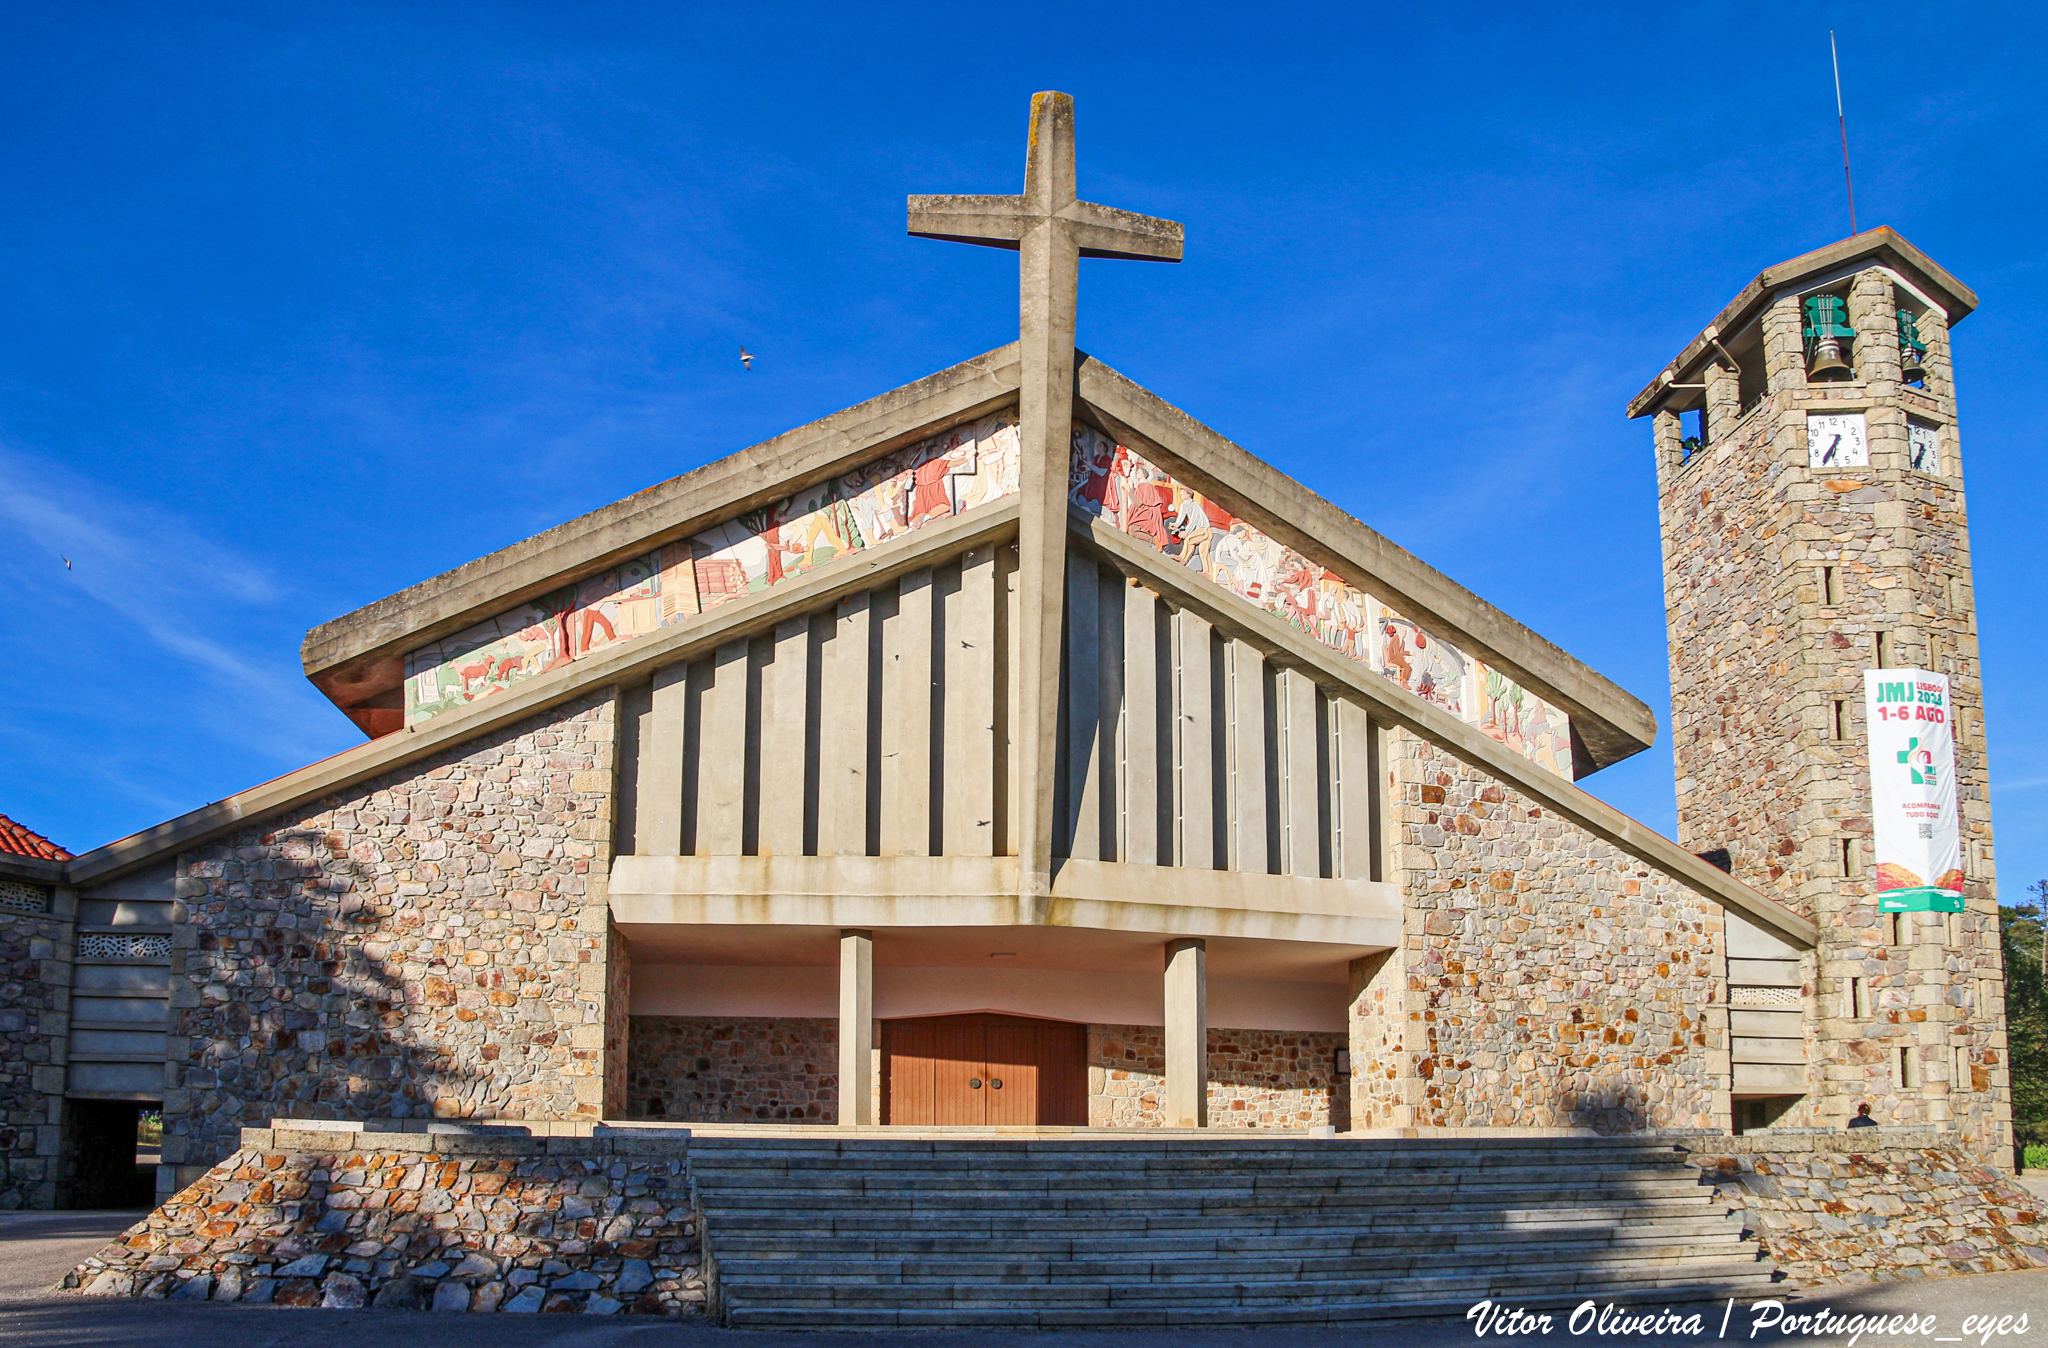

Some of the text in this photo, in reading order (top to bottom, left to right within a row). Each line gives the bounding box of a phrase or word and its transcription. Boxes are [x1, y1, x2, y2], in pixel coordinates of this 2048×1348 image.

[1818, 421, 1825, 430] 11
[1829, 417, 1838, 426] 12
[1842, 420, 1846, 428] 1
[1810, 429, 1818, 437] 10
[1851, 427, 1856, 436] 2
[1914, 425, 1920, 435] 12
[1922, 431, 1926, 439] 1
[1808, 439, 1814, 447] 9
[1855, 437, 1860, 446] 3
[1929, 440, 1932, 448] 2
[1814, 449, 1820, 457] 8
[1932, 450, 1936, 459] 3
[1834, 458, 1840, 467] 6
[1844, 456, 1850, 464] 5
[1877, 682, 1914, 702] JMJ
[1918, 690, 1942, 706] 2023
[1878, 706, 1944, 724] 1-6 AGO
